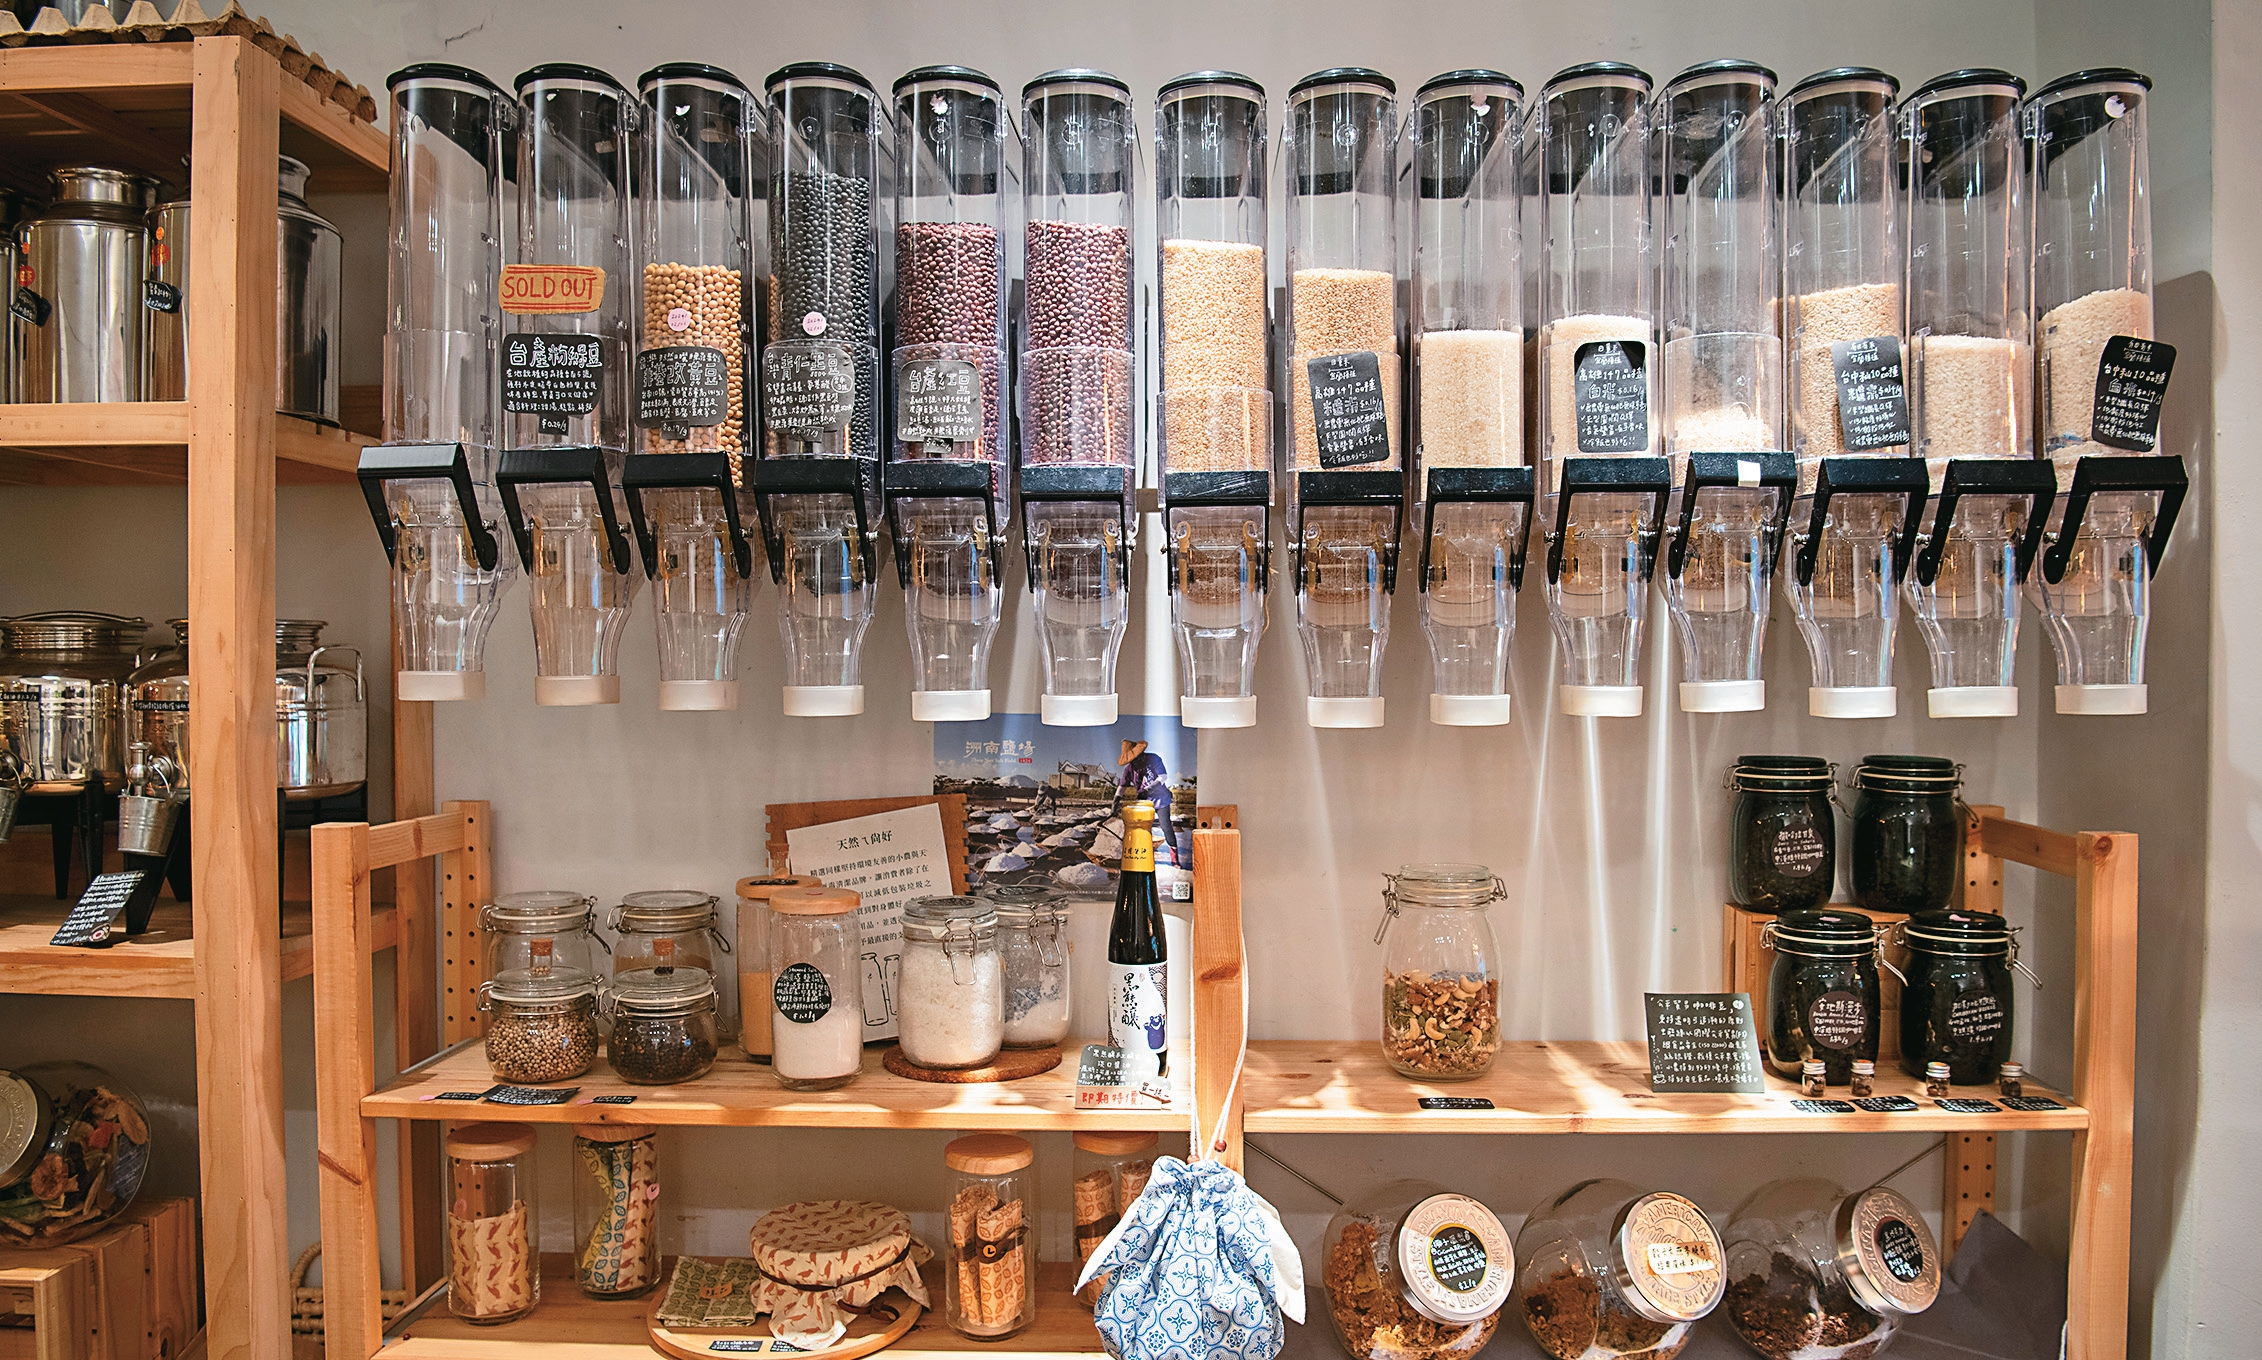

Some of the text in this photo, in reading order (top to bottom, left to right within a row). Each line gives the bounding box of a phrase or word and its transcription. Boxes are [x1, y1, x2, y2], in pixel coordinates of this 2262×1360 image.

[501, 275, 598, 301] SOLD OUT
[963, 739, 1036, 759] 洲南鹽場
[810, 849, 927, 877] 精選同樣堅持環境友善的小農與天
